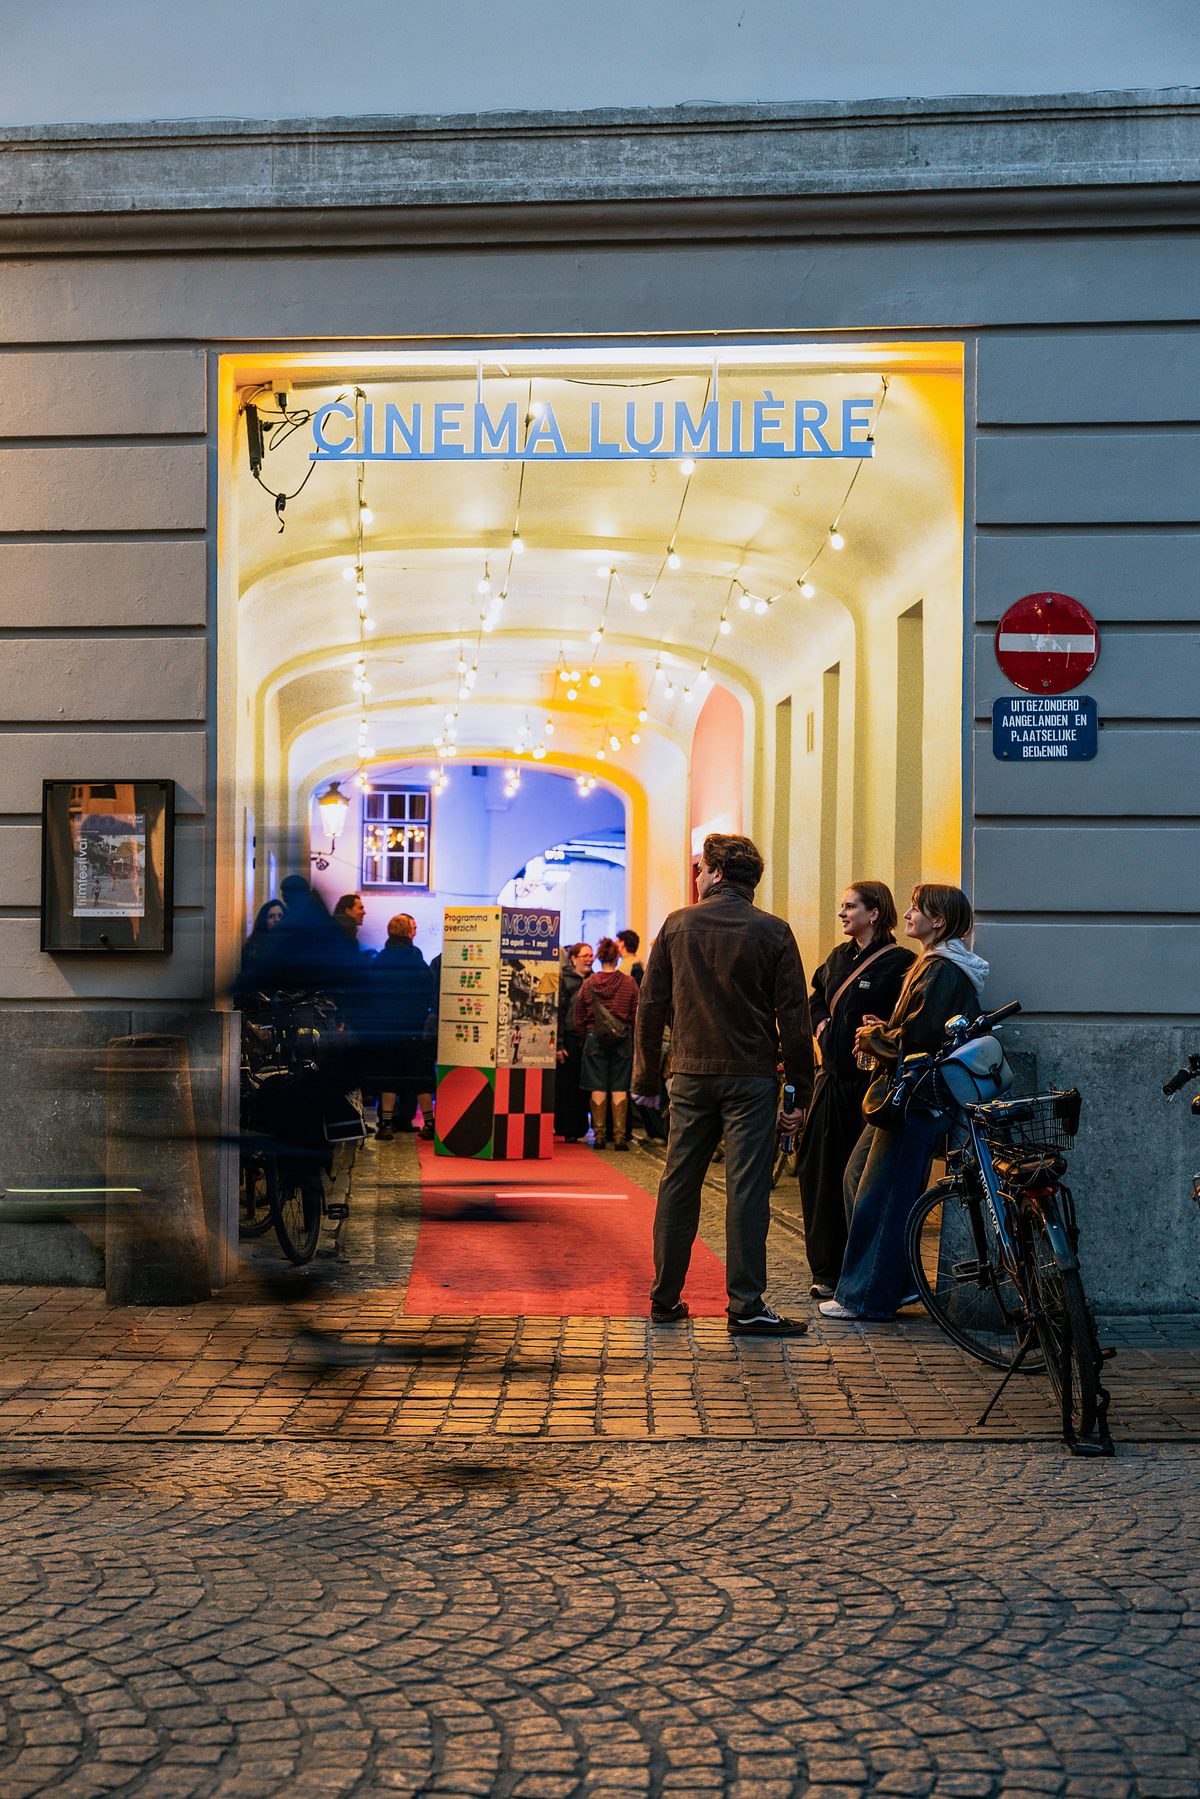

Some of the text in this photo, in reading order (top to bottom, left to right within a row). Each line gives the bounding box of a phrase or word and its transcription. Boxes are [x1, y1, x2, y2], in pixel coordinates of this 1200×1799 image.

[311, 390, 874, 454] CINEMA LUMIÈRE
[1011, 699, 1079, 712] UITGEZONDERD
[1002, 714, 1087, 727] AANGELANDEN EN
[1011, 729, 1077, 742] PLAATSELIJKE
[1022, 744, 1068, 758] BEDIENING
[77, 837, 88, 906] filmfestival
[444, 913, 488, 922] Programma
[444, 924, 477, 932] overzicht
[498, 965, 513, 1063] filmfestival
